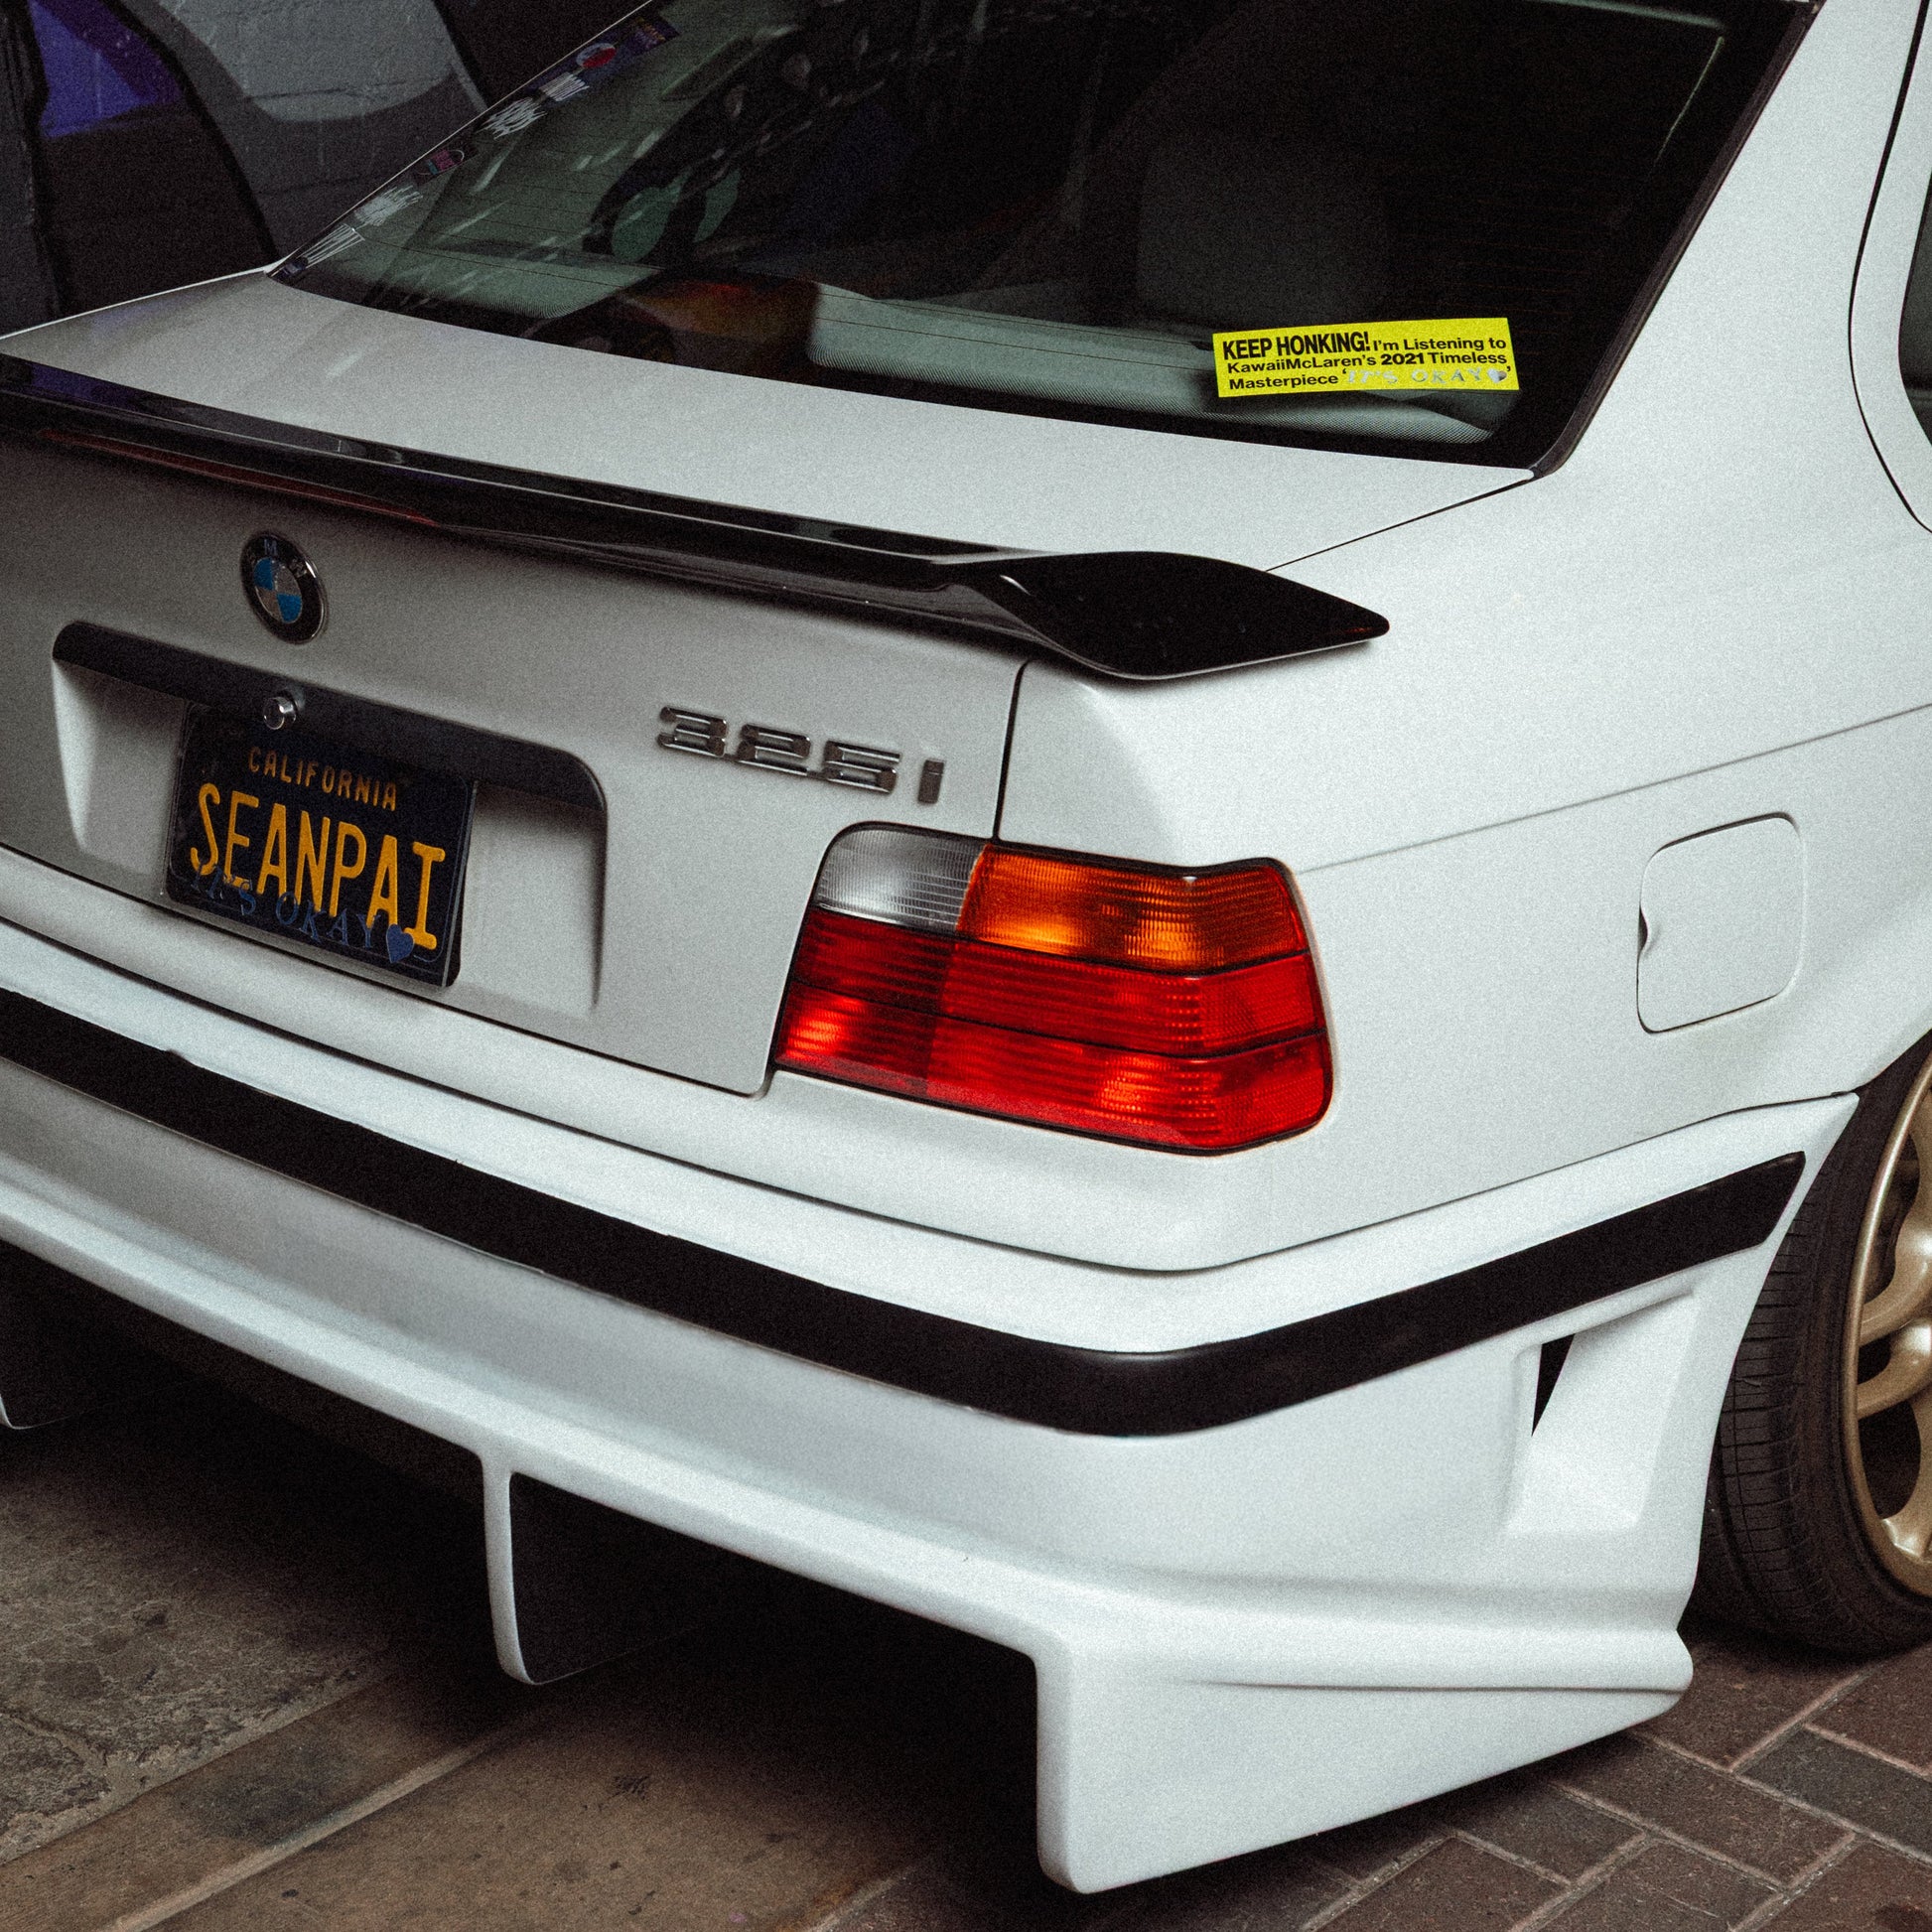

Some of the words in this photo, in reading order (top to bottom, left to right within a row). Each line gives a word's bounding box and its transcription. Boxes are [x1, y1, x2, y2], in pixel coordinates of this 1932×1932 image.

[1222, 338, 1272, 360] KEEP
[1276, 331, 1371, 356] HONKING!
[1373, 341, 1399, 351] I'm
[1404, 338, 1484, 351] Listening
[1488, 338, 1507, 349] to
[1227, 354, 1377, 374] KawaiiMcLaren's
[1380, 352, 1425, 365] 2021
[1428, 351, 1508, 364] Timeless
[1229, 374, 1339, 390] Masterpiece
[247, 747, 397, 812] CALIFORNIA
[190, 782, 446, 950] SEANPAI
[275, 892, 381, 949] OKAY
